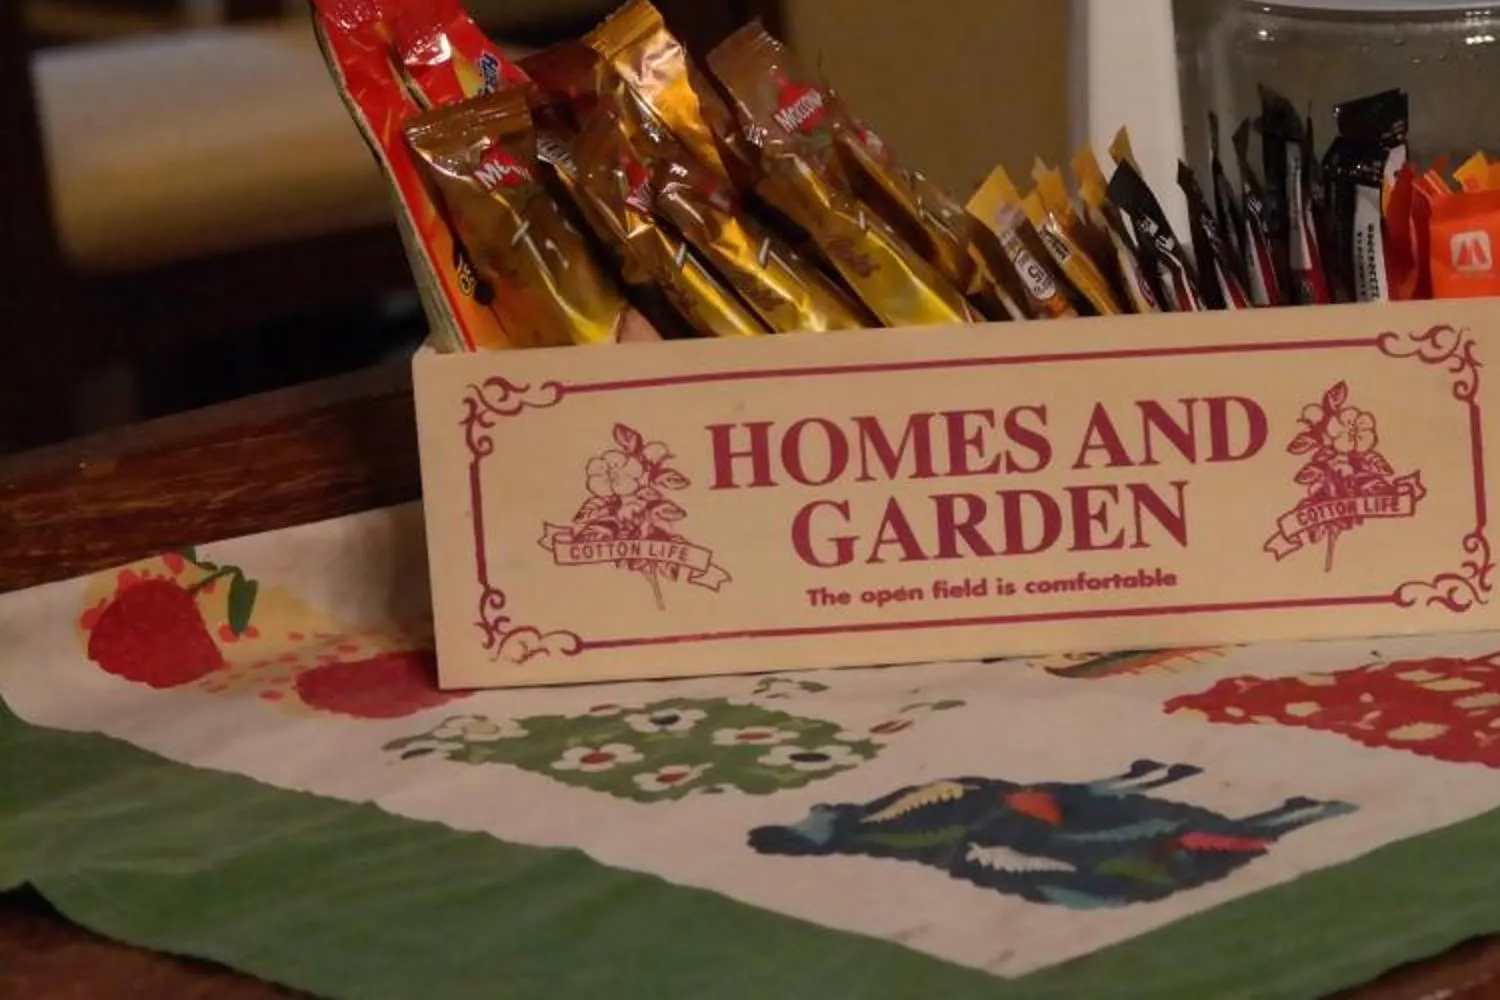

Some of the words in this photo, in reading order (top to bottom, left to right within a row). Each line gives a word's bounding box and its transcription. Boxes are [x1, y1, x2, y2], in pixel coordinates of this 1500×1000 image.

[705, 404, 1053, 490] HOMES
[1071, 395, 1268, 470] AND
[569, 541, 641, 560] COTTON
[648, 544, 689, 562] LIFE
[791, 480, 1188, 568] GARDEN
[806, 587, 851, 607] The
[861, 585, 924, 609] open
[932, 577, 988, 600] field
[997, 577, 1016, 598] is
[1025, 568, 1179, 596] comfortable
